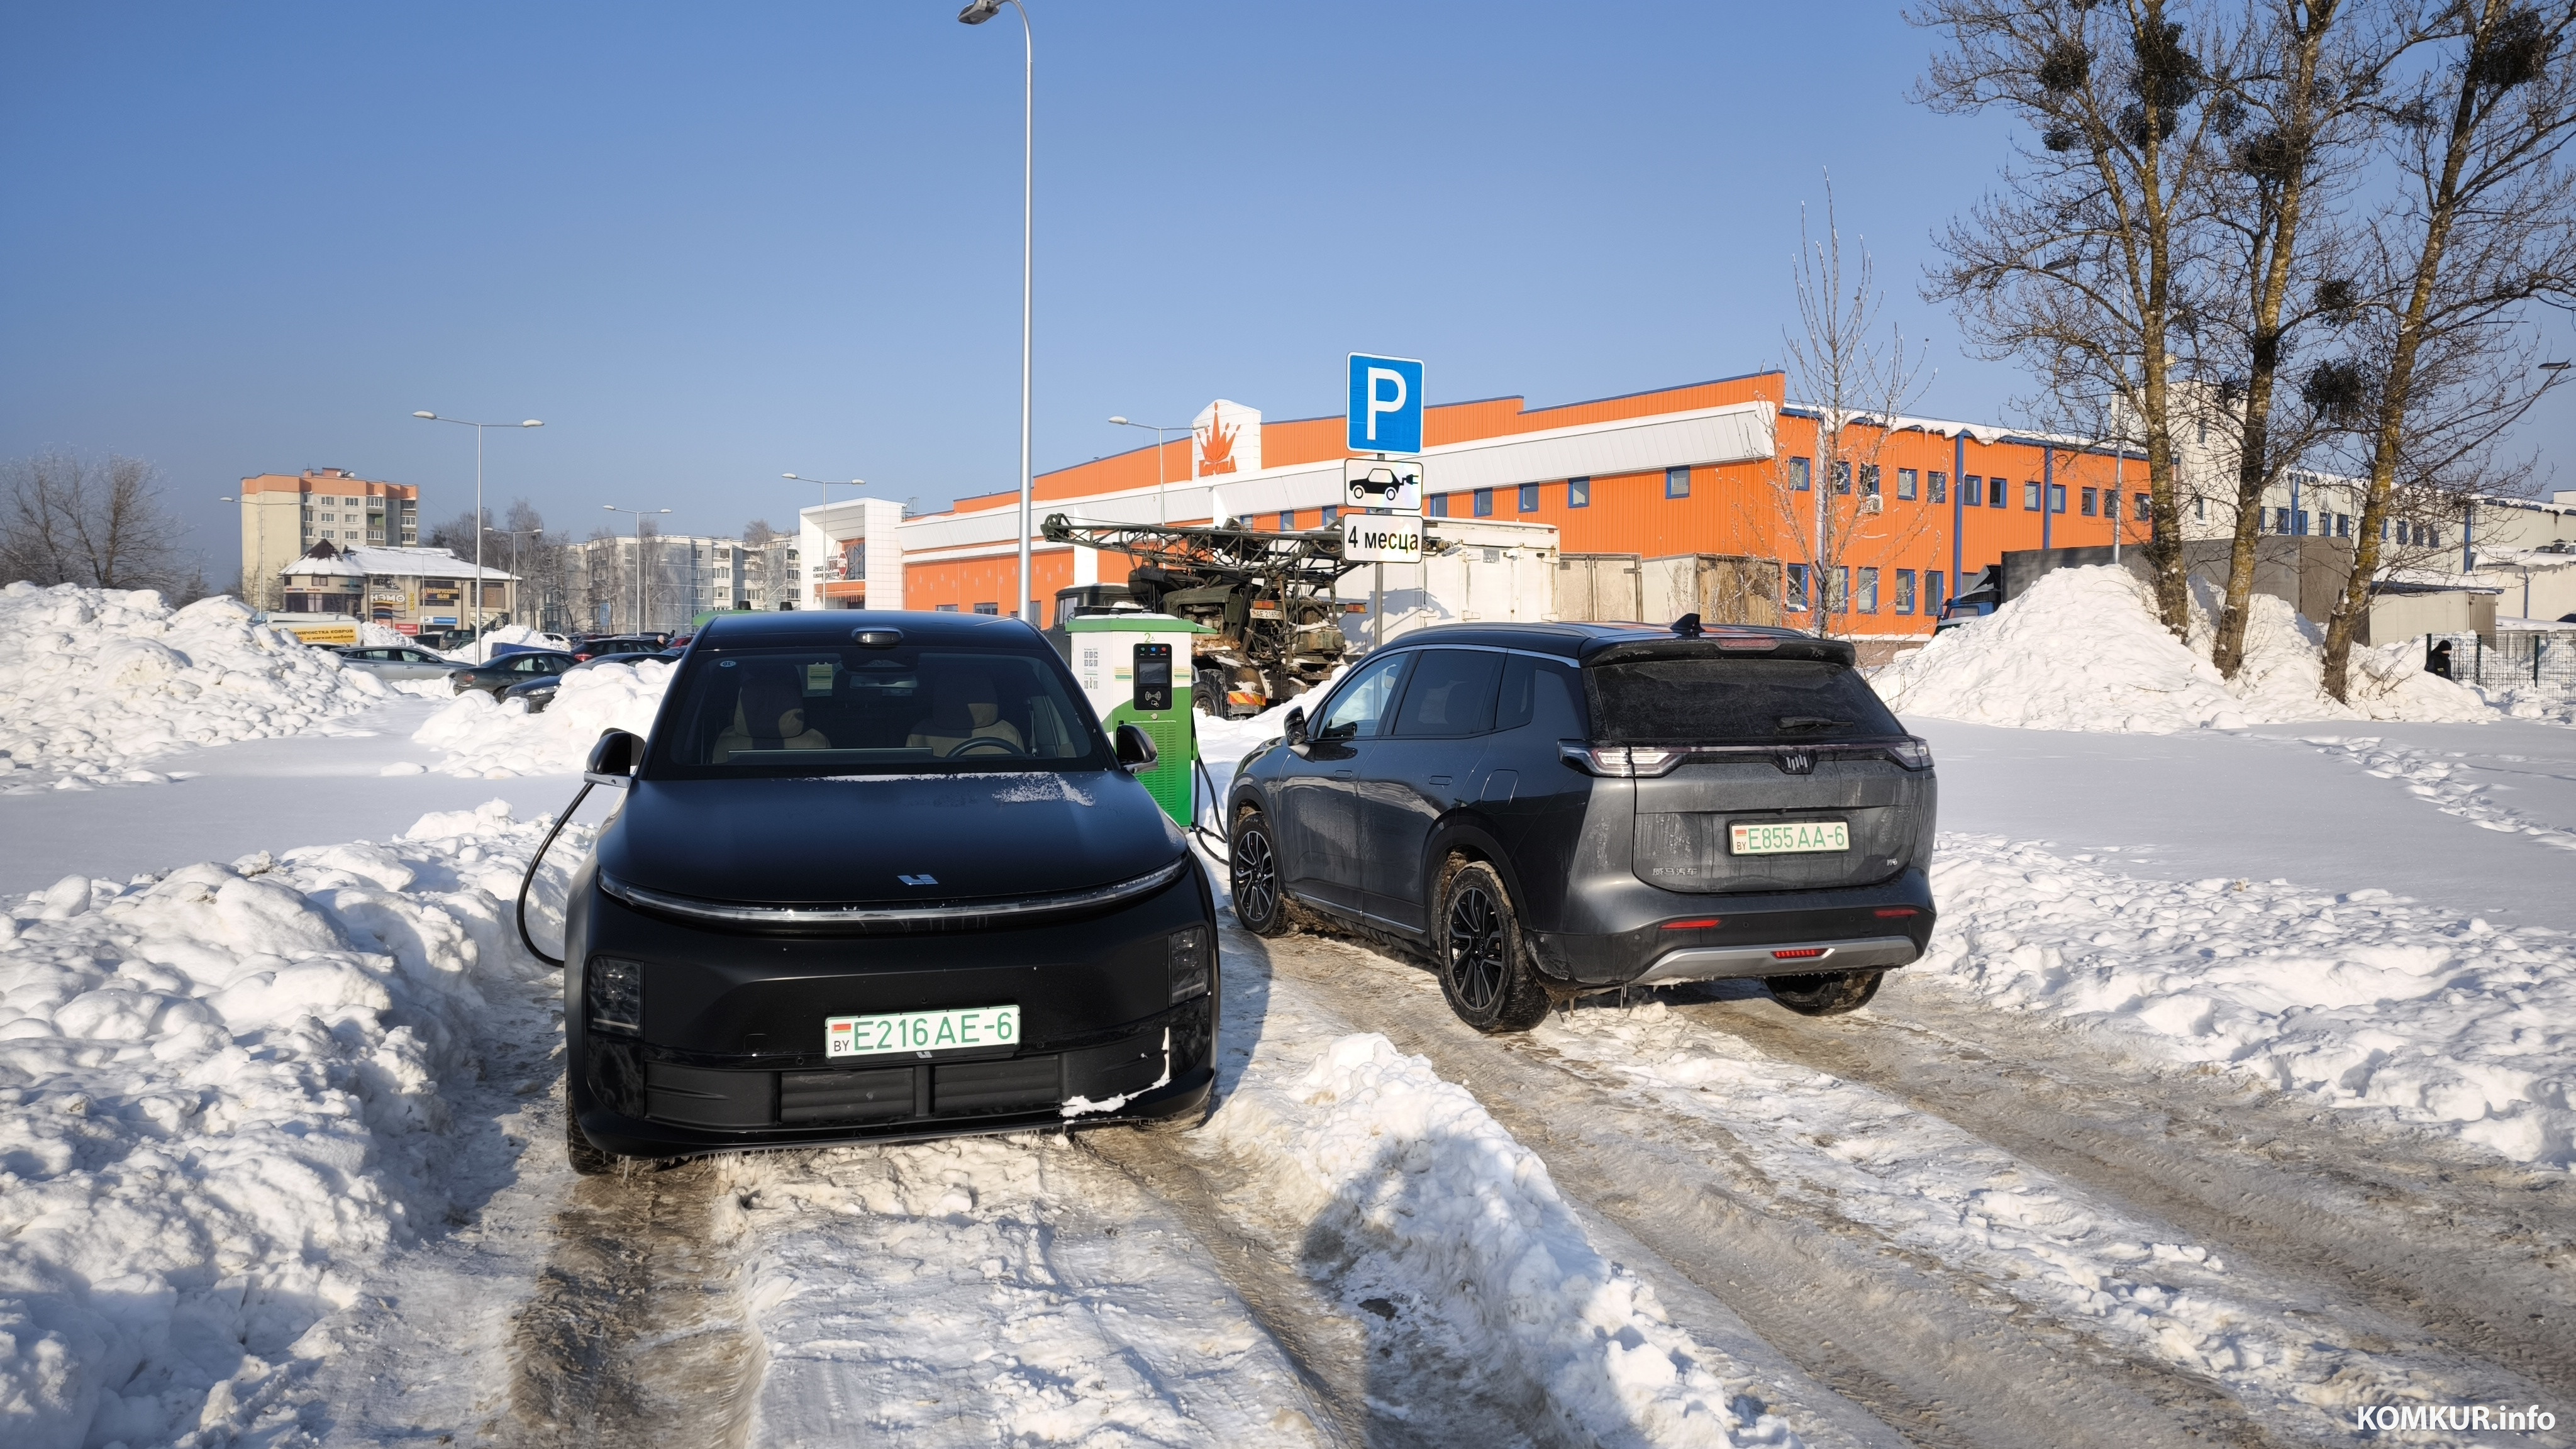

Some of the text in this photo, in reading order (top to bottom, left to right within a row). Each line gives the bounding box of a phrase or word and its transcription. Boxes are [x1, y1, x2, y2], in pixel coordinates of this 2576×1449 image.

[1367, 367, 1407, 441] P
[1348, 525, 1418, 554] 4 месца
[370, 594, 406, 602] НЭМО
[1736, 841, 1746, 850] BY
[1652, 867, 1697, 876] 威马汽车
[833, 1040, 850, 1052] BY
